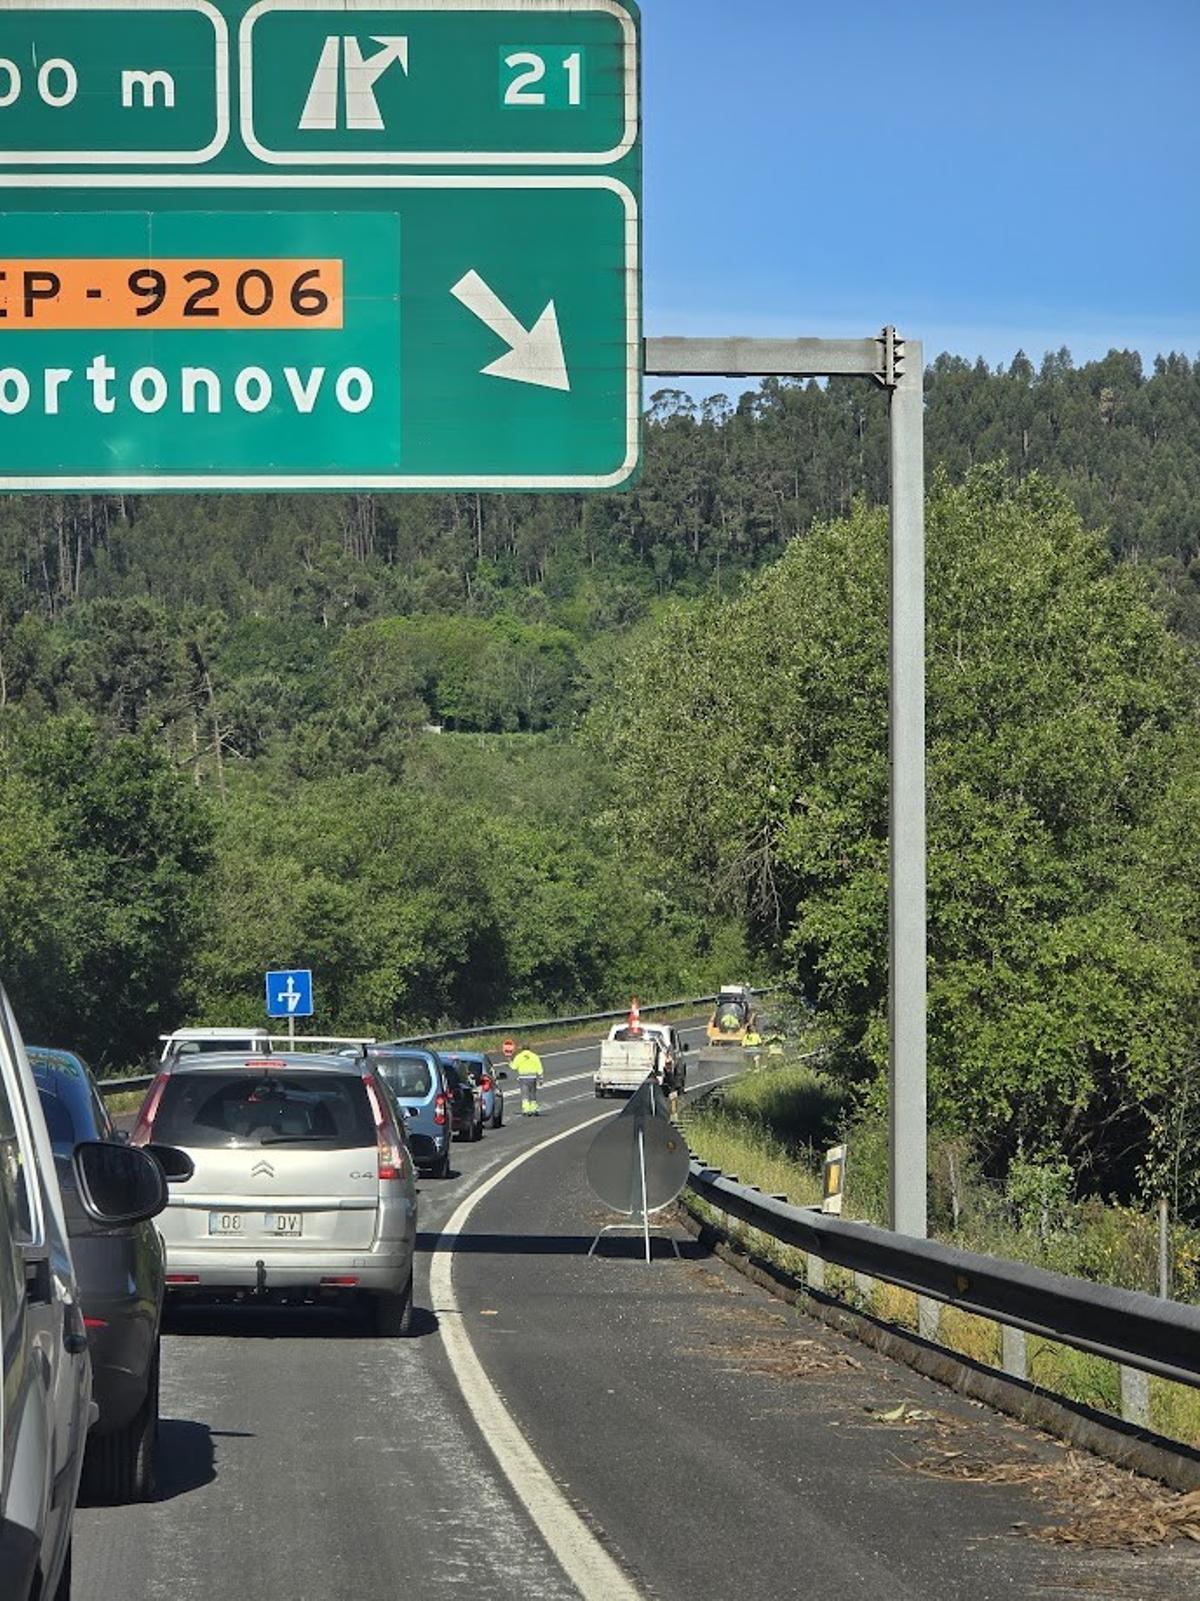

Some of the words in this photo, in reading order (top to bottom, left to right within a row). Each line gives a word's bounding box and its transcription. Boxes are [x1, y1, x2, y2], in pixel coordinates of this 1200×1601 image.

[121, 70, 175, 107] m
[505, 53, 580, 105] 21
[0, 270, 328, 317] P-9206
